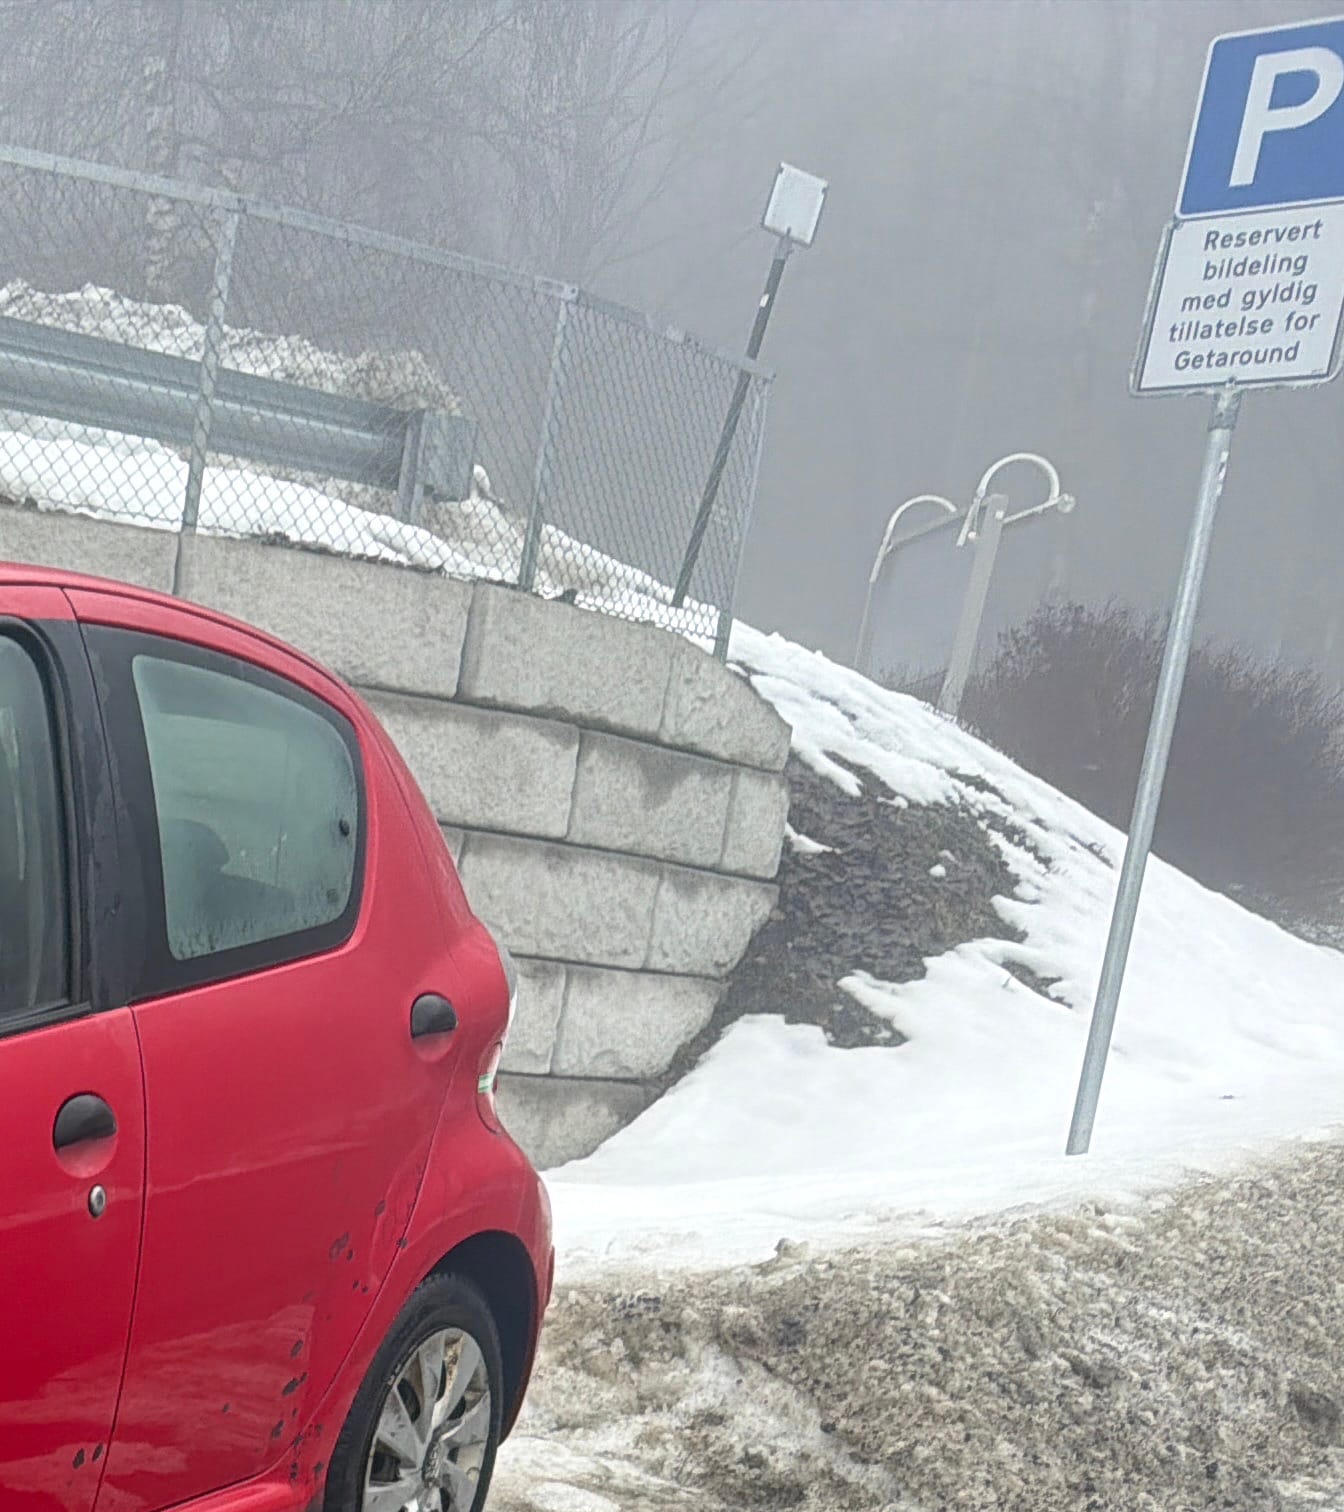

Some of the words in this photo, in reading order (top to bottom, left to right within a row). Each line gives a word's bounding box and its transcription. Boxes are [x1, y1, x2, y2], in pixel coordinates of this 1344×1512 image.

[1229, 46, 1343, 188] P
[1204, 219, 1323, 251] Reservert
[1203, 253, 1308, 280] bildeling
[1181, 288, 1231, 312] med
[1242, 281, 1318, 310] gyldig
[1170, 313, 1273, 342] tillatelse
[1285, 311, 1321, 332] for
[1174, 342, 1300, 371] Getaround
